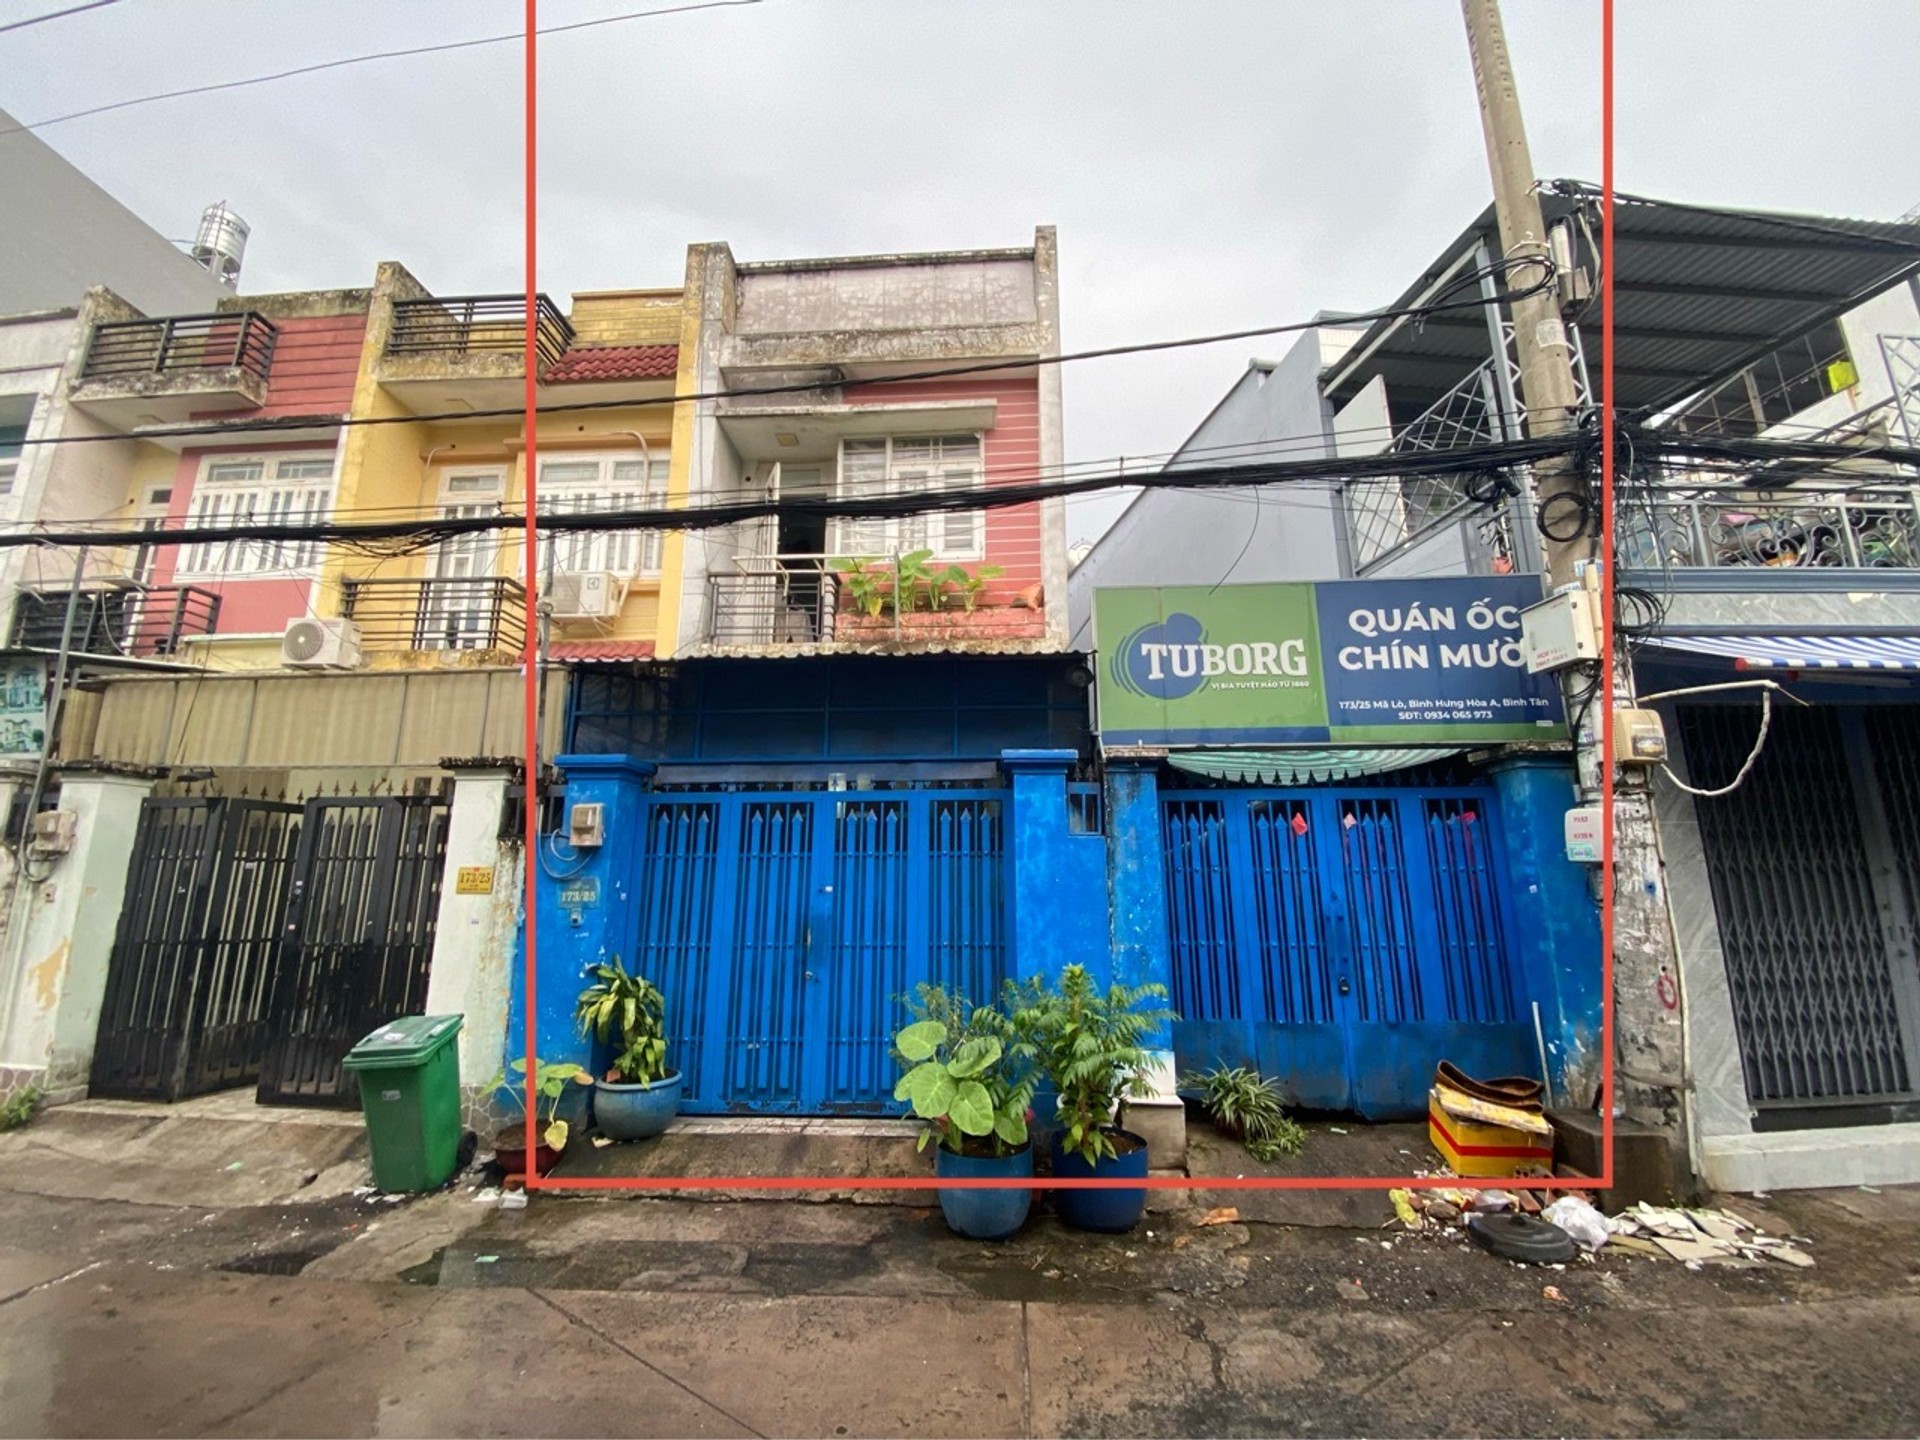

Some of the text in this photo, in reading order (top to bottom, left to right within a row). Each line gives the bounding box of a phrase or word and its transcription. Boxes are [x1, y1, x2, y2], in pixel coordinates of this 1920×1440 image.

[1348, 597, 1520, 637] QUÁN ỐC
[1141, 638, 1308, 680] TUBORG
[1338, 639, 1430, 671] CHÍN
[1339, 699, 1371, 709] 173/25
[1391, 699, 1407, 710] Lò,
[1408, 699, 1433, 708] Bình
[1435, 698, 1465, 709] Hưng
[1466, 698, 1488, 707] Hòa
[1489, 698, 1501, 708] A,
[1502, 698, 1527, 707] Bình
[1529, 697, 1550, 707] Tân
[1398, 710, 1493, 720] SĐT: 0934 065 973
[459, 871, 491, 884] 173/25
[560, 890, 597, 902] 173/25
